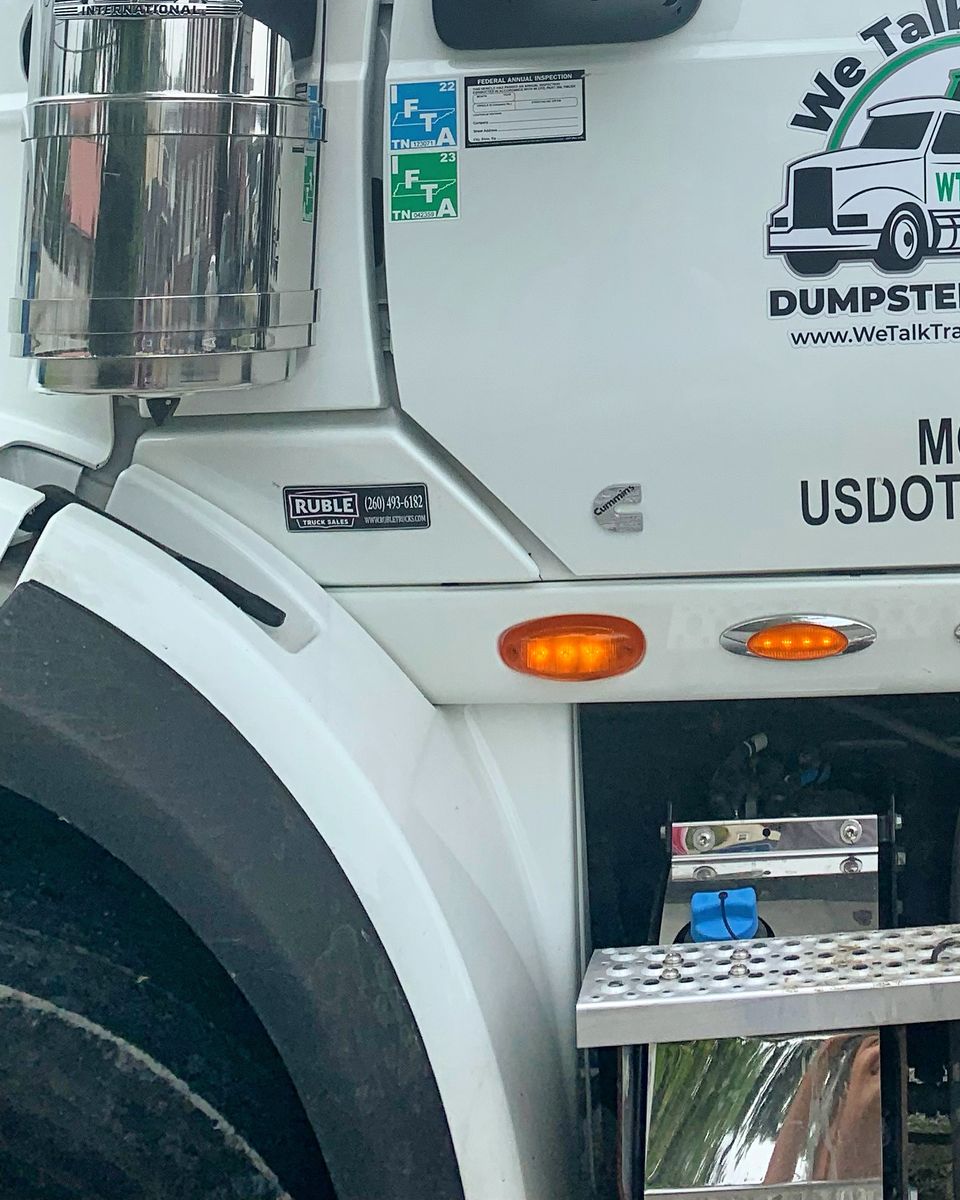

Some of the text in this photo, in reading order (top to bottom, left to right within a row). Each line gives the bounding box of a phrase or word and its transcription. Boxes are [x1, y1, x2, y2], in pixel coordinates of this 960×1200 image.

[80, 4, 200, 16] INTERNATIONAL
[477, 73, 573, 85] FEDERAL ANNUAL INSPECTION
[439, 82, 455, 92] 22
[791, 57, 866, 132] We
[391, 139, 410, 149] TN
[440, 152, 456, 162] 23
[392, 210, 411, 220] TN
[295, 498, 354, 514] RUBLE
[364, 494, 423, 512] (260) 493-6182
[593, 485, 635, 516] Cummins
